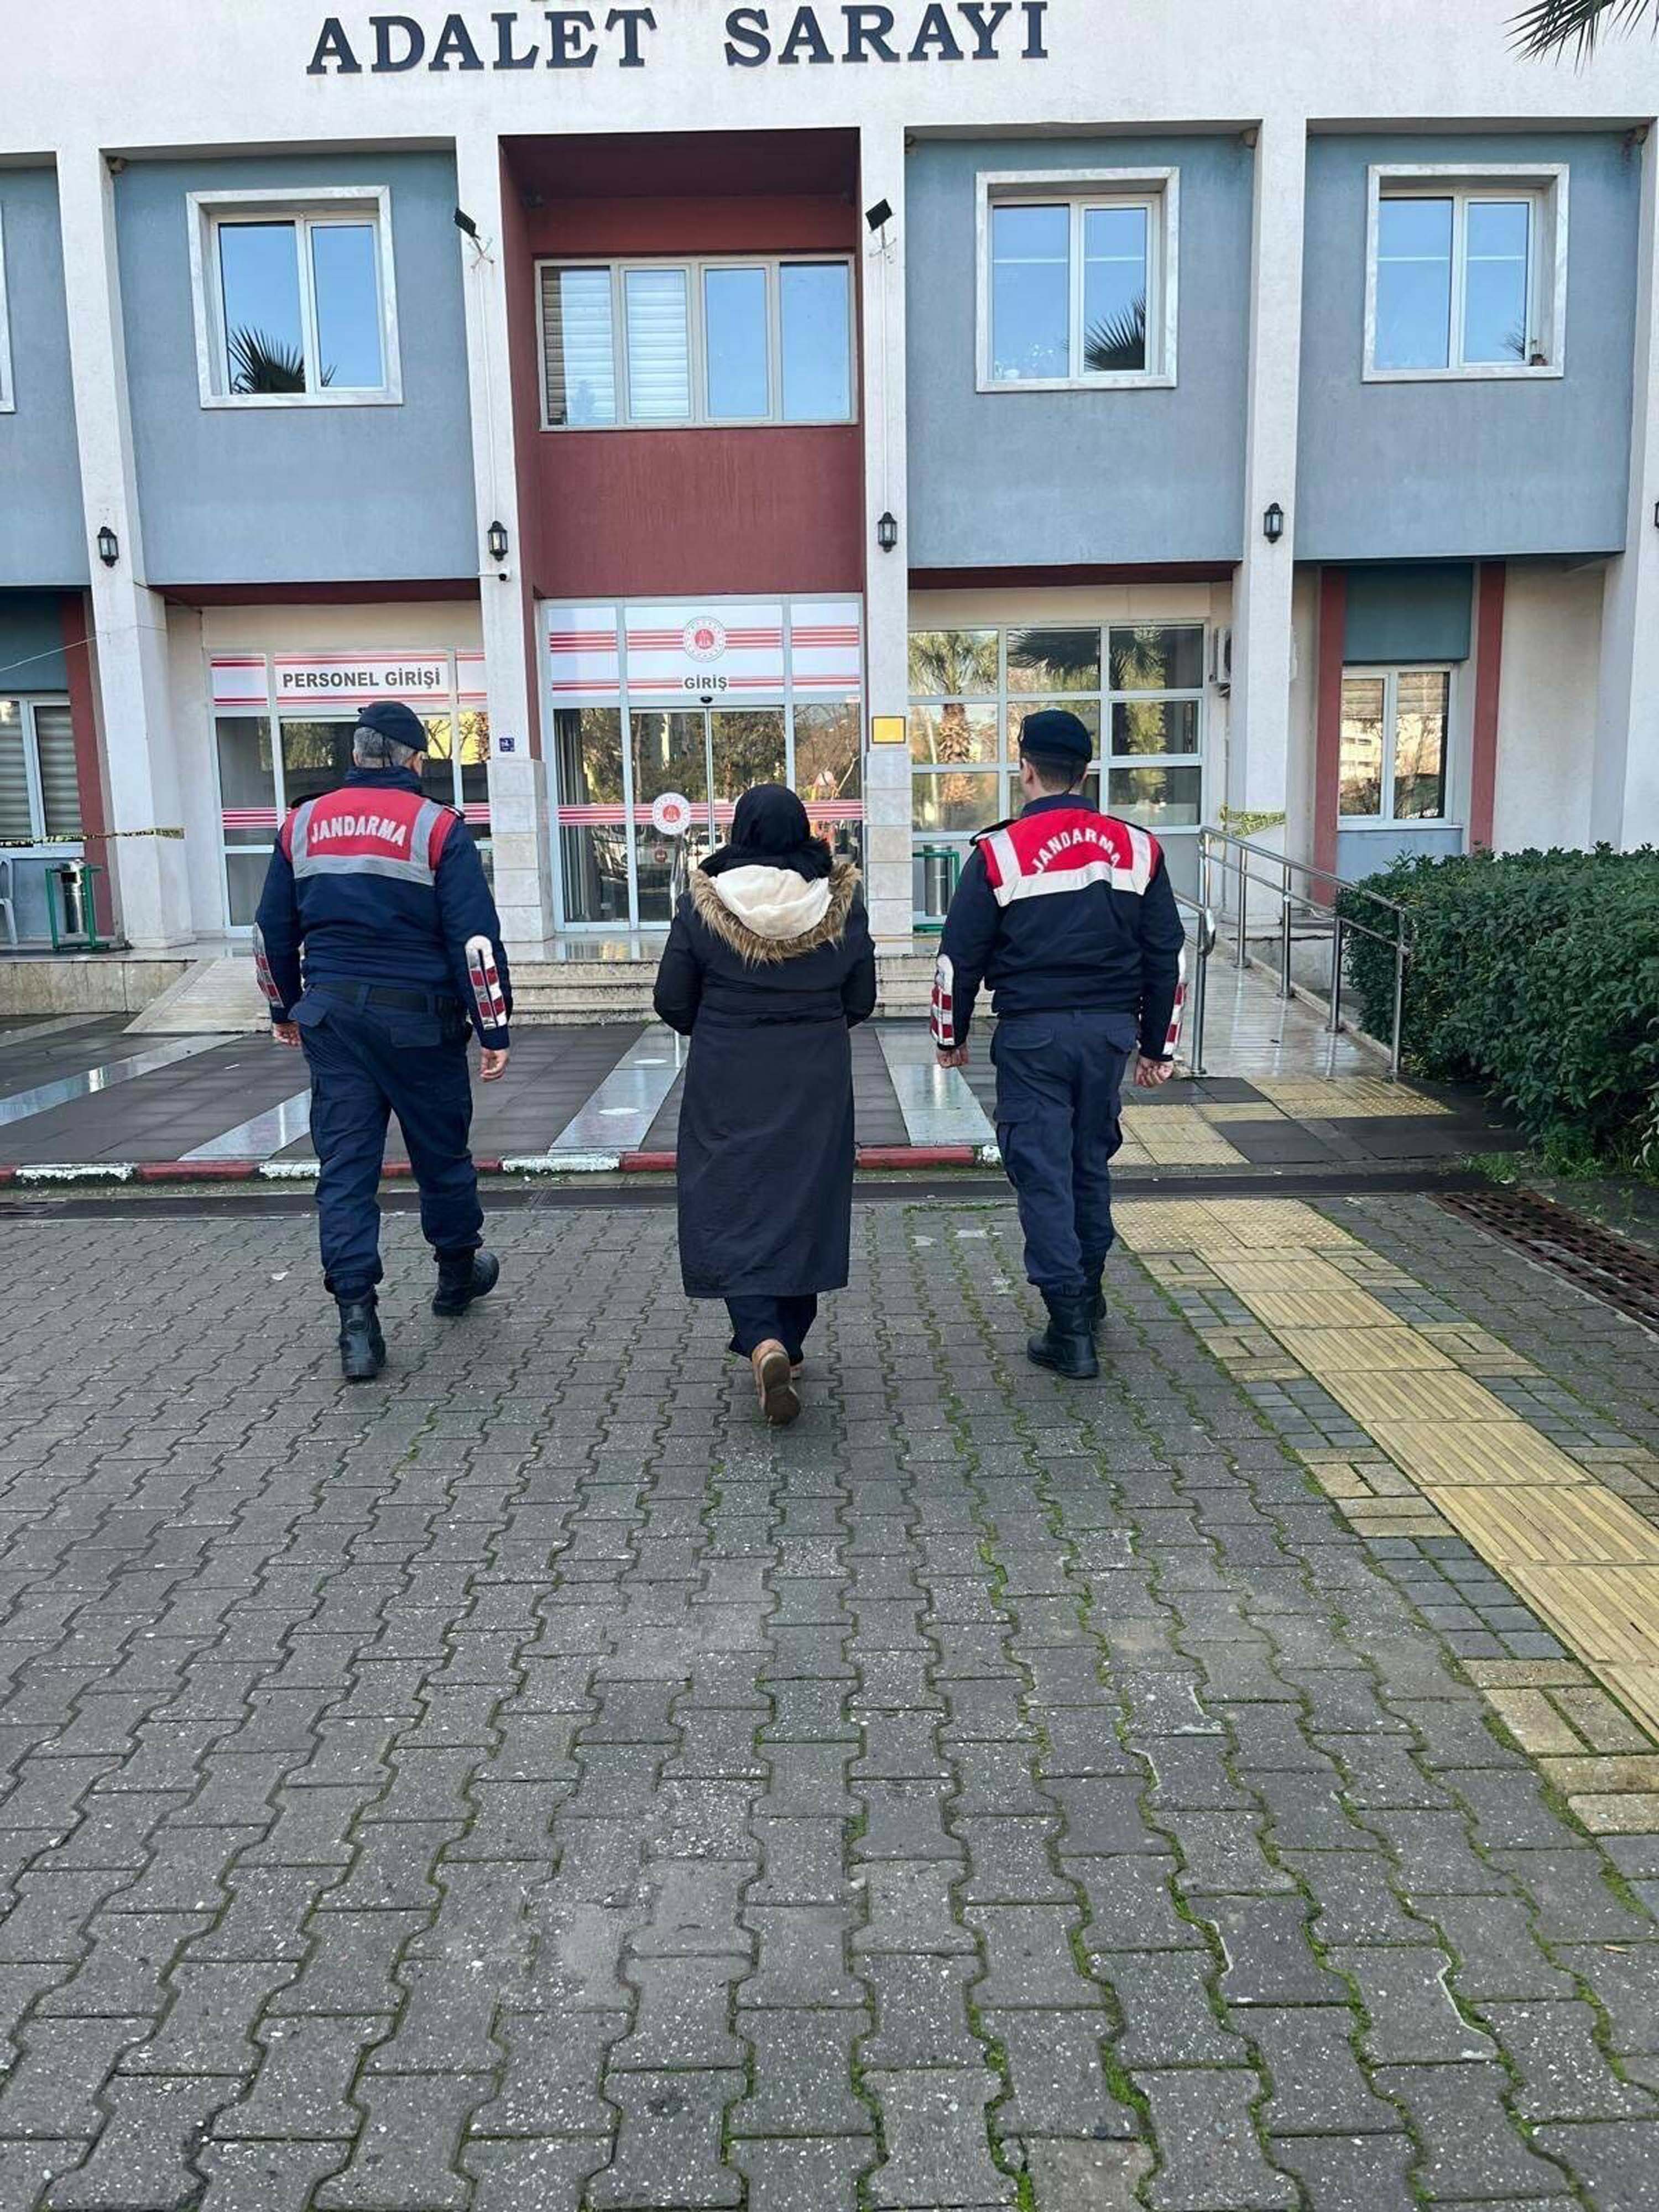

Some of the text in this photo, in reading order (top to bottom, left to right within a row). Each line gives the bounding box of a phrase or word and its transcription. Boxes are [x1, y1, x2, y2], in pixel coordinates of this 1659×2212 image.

[306, 1, 1048, 75] ADALET SARAYI
[283, 667, 440, 689] PERSONEL GİRİŞİ
[685, 674, 727, 691] GİRİŞ
[311, 815, 407, 847] JANDARMA
[1032, 828, 1121, 874] JANDARMA
